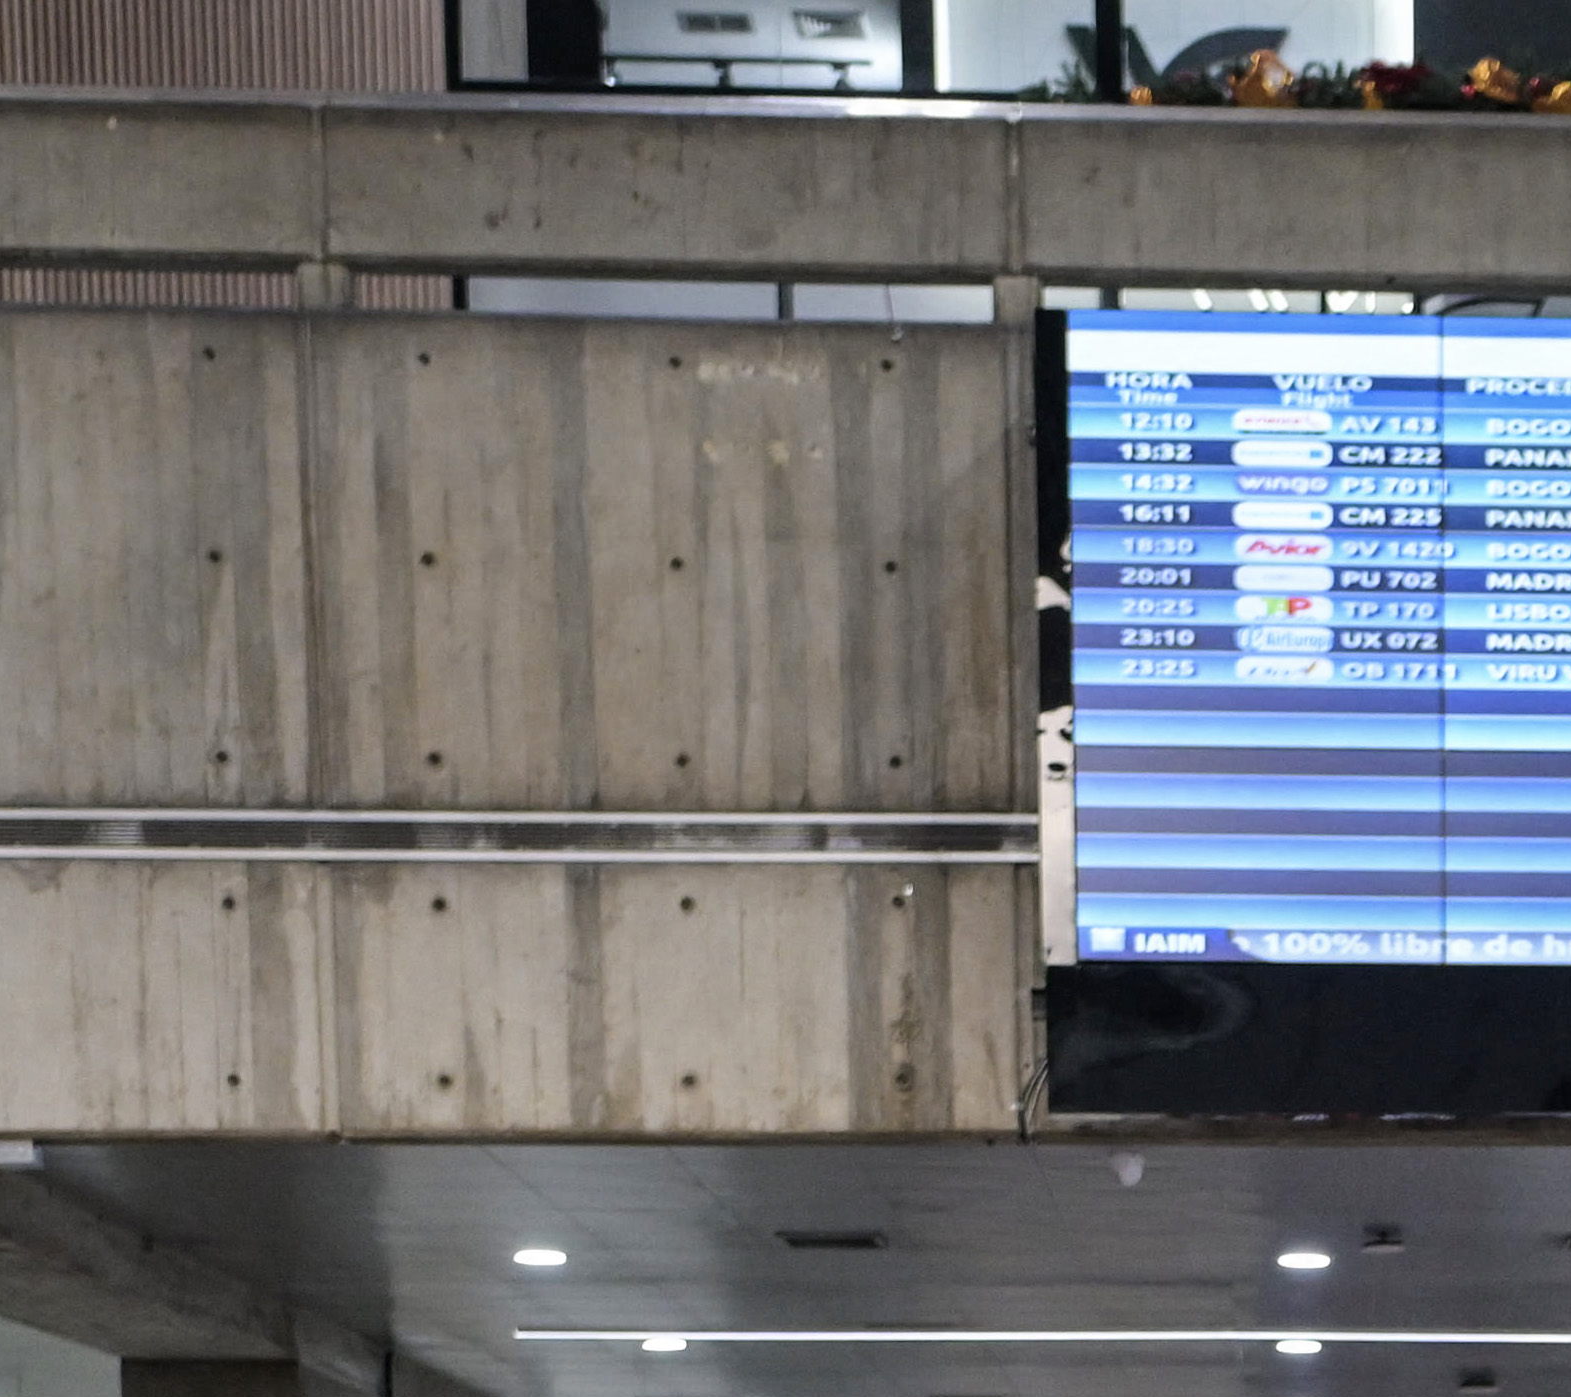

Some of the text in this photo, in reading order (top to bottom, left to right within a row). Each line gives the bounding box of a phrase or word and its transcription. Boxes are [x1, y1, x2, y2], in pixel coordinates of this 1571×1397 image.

[1105, 372, 1194, 391] HORA
[1271, 374, 1373, 393] VUELO
[1119, 389, 1179, 406] Time
[1280, 392, 1354, 410] Flight
[1121, 412, 1195, 431] 12:10
[1340, 415, 1381, 434] AV
[1390, 416, 1440, 434] 143
[1119, 442, 1195, 463] 13:32
[1339, 446, 1385, 466] CM
[1391, 446, 1442, 467] 222
[1121, 473, 1195, 493] 14:32
[1119, 504, 1192, 523] 16:11
[1340, 507, 1385, 527] CM
[1122, 536, 1196, 556] 18:30
[1119, 567, 1192, 586] 20:01
[1340, 571, 1381, 588] PU
[1387, 571, 1438, 590] 702
[1121, 598, 1195, 618] 20:25
[1342, 601, 1380, 619] TP
[1388, 602, 1435, 620] 170
[1119, 628, 1196, 648] 23:10
[1340, 632, 1384, 650] UX
[1387, 632, 1439, 651] 072
[1121, 659, 1196, 679] 23:25
[1486, 664, 1557, 683] VIRU
[1135, 934, 1206, 955] IAIM
[1264, 932, 1370, 956] 100%
[1380, 932, 1474, 957] libre
[1483, 934, 1533, 958] de
